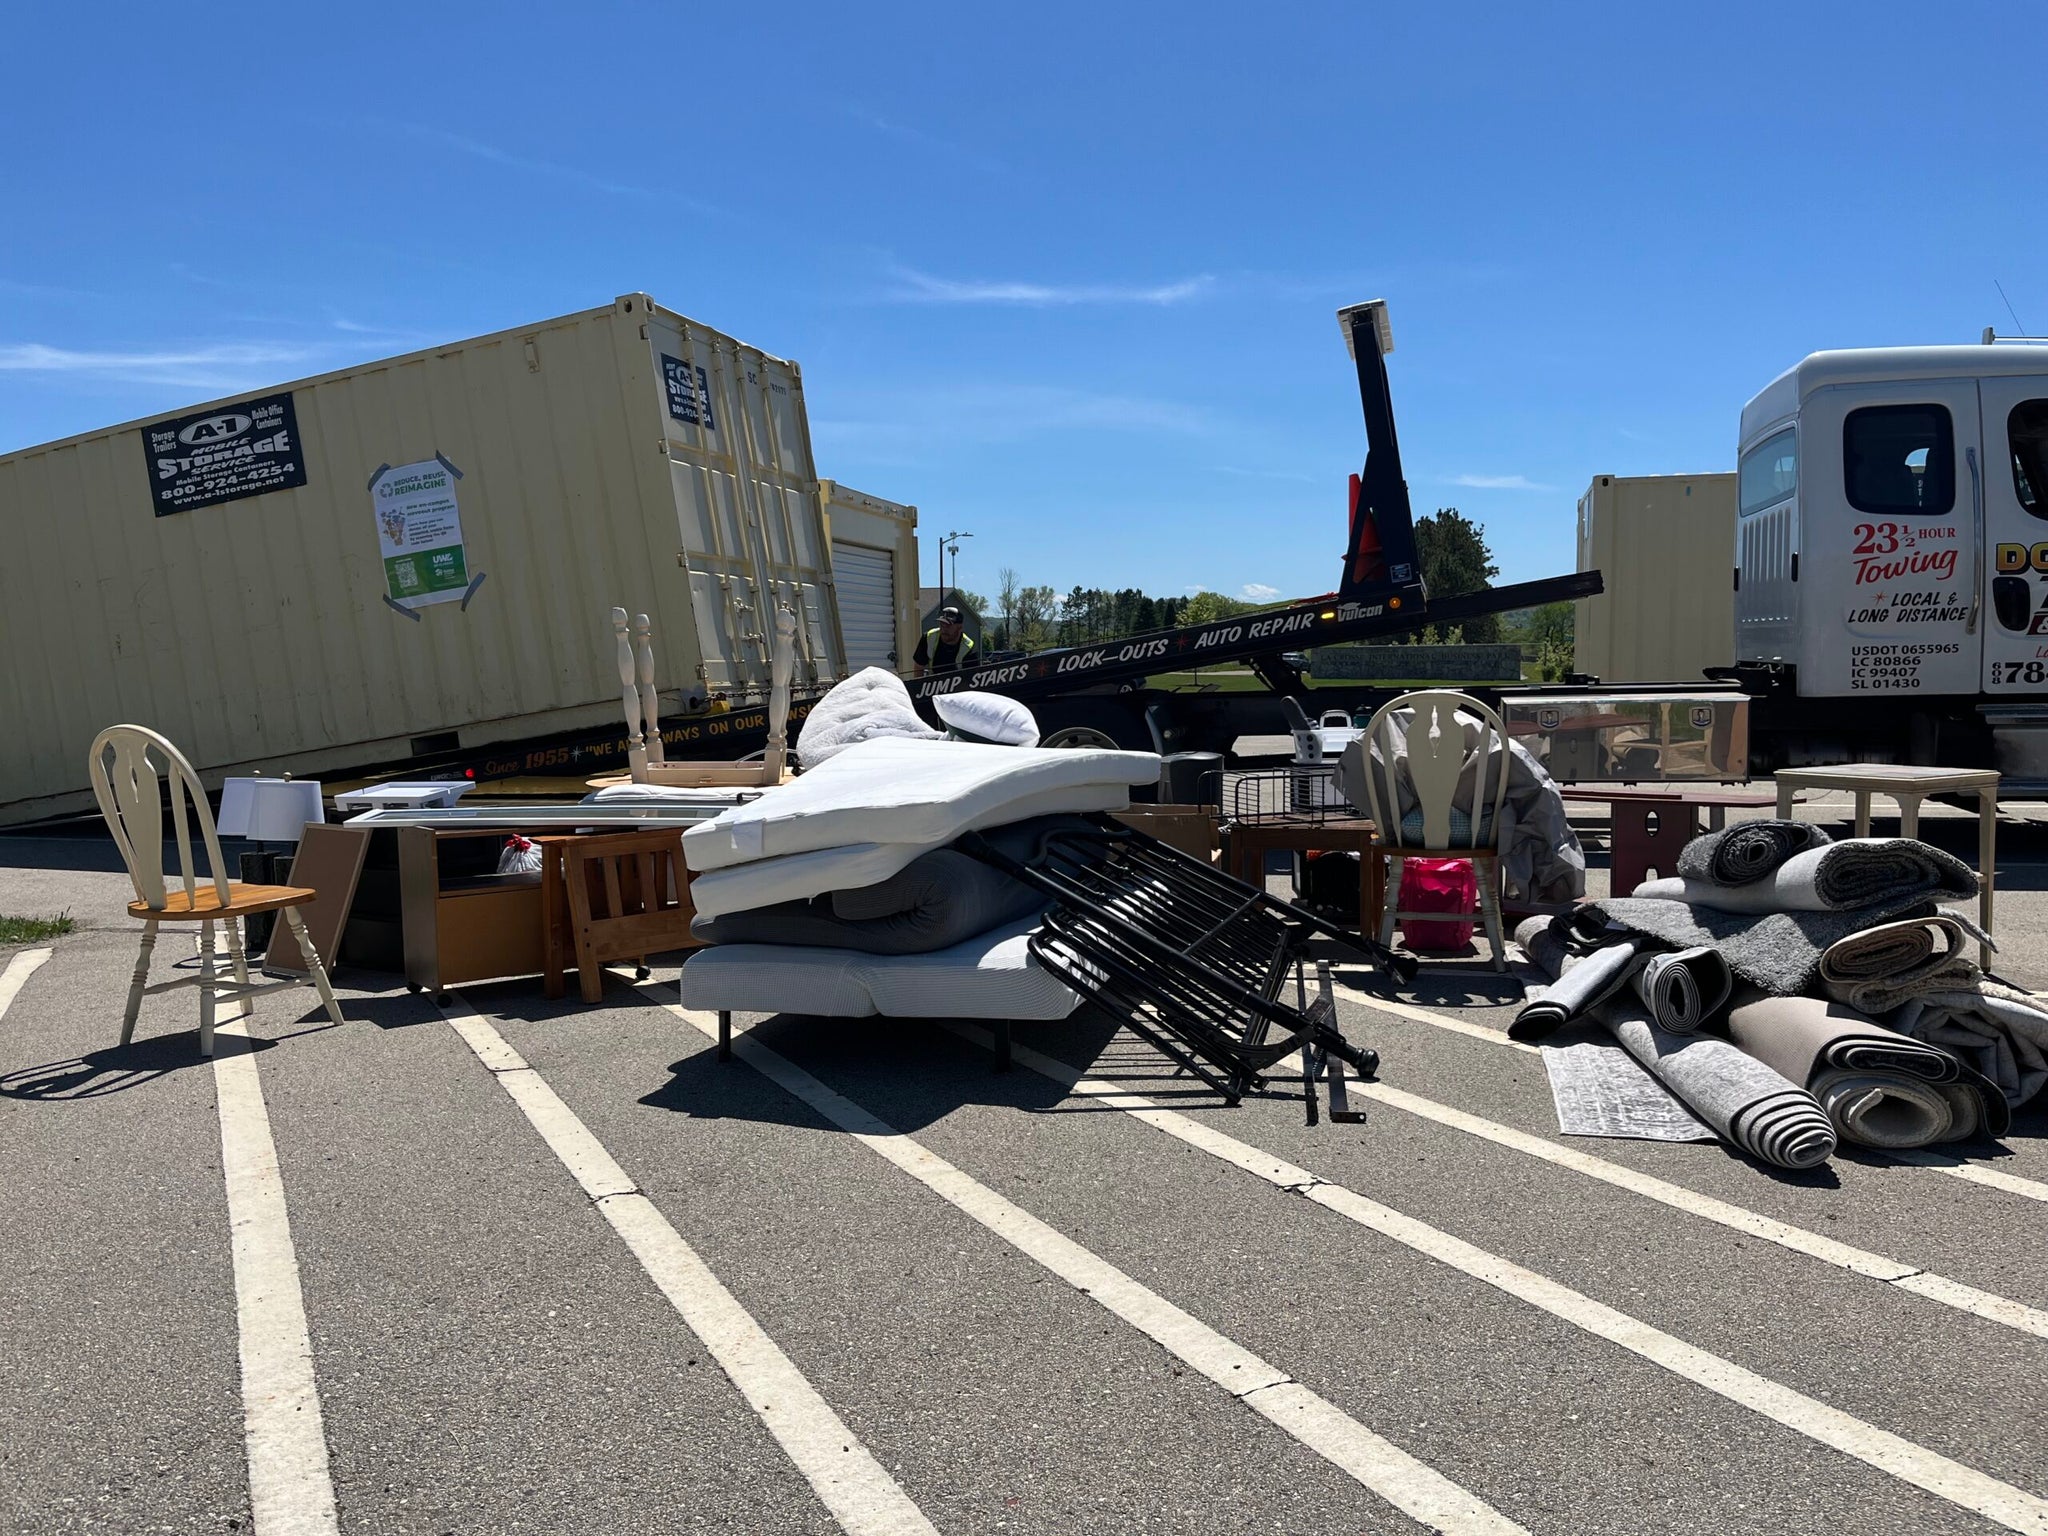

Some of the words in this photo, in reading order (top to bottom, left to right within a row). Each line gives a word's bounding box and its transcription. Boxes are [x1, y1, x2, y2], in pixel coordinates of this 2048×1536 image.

[251, 407, 269, 420] Mobile
[268, 404, 284, 416] Office
[191, 417, 238, 442] A-1
[256, 416, 283, 430] Containers
[151, 430, 175, 443] Storage
[190, 437, 252, 456] MOBILE
[153, 440, 177, 454] Trailers
[157, 430, 290, 480] STORAGE
[176, 475, 202, 486] Mobile
[203, 468, 233, 482] Storage
[233, 460, 276, 474] Containers
[190, 454, 257, 476] SERVICE
[161, 462, 295, 500] 800-924-4254
[173, 475, 286, 505] www.a-1storage.net
[394, 477, 447, 497] REIMAGINE
[1852, 522, 1899, 555] 23
[1918, 527, 1956, 539] HOUR
[1852, 549, 1959, 586] Towing
[1891, 592, 1941, 608] LOCAL
[1336, 603, 1384, 623] Vulcan
[1848, 609, 1889, 624] LONG
[1896, 606, 1969, 623] DISTANCE
[915, 676, 962, 699] JUMP
[969, 663, 1029, 689] STARTS
[1194, 626, 1242, 650] AUTO
[1248, 612, 1315, 639] REPAIR
[1851, 645, 1899, 657] USDOT
[1901, 643, 1960, 655] 0655965
[1851, 657, 1870, 667] LC
[1872, 655, 1922, 667] 80866
[1851, 668, 1868, 678] IC
[1868, 667, 1918, 678] 99407
[1851, 679, 1870, 690] SL
[1872, 678, 1921, 689] 01430
[484, 760, 520, 776] Since
[525, 746, 570, 769] 1955
[661, 726, 700, 744] WAYS
[708, 720, 729, 735] ON
[735, 714, 765, 729] OUR
